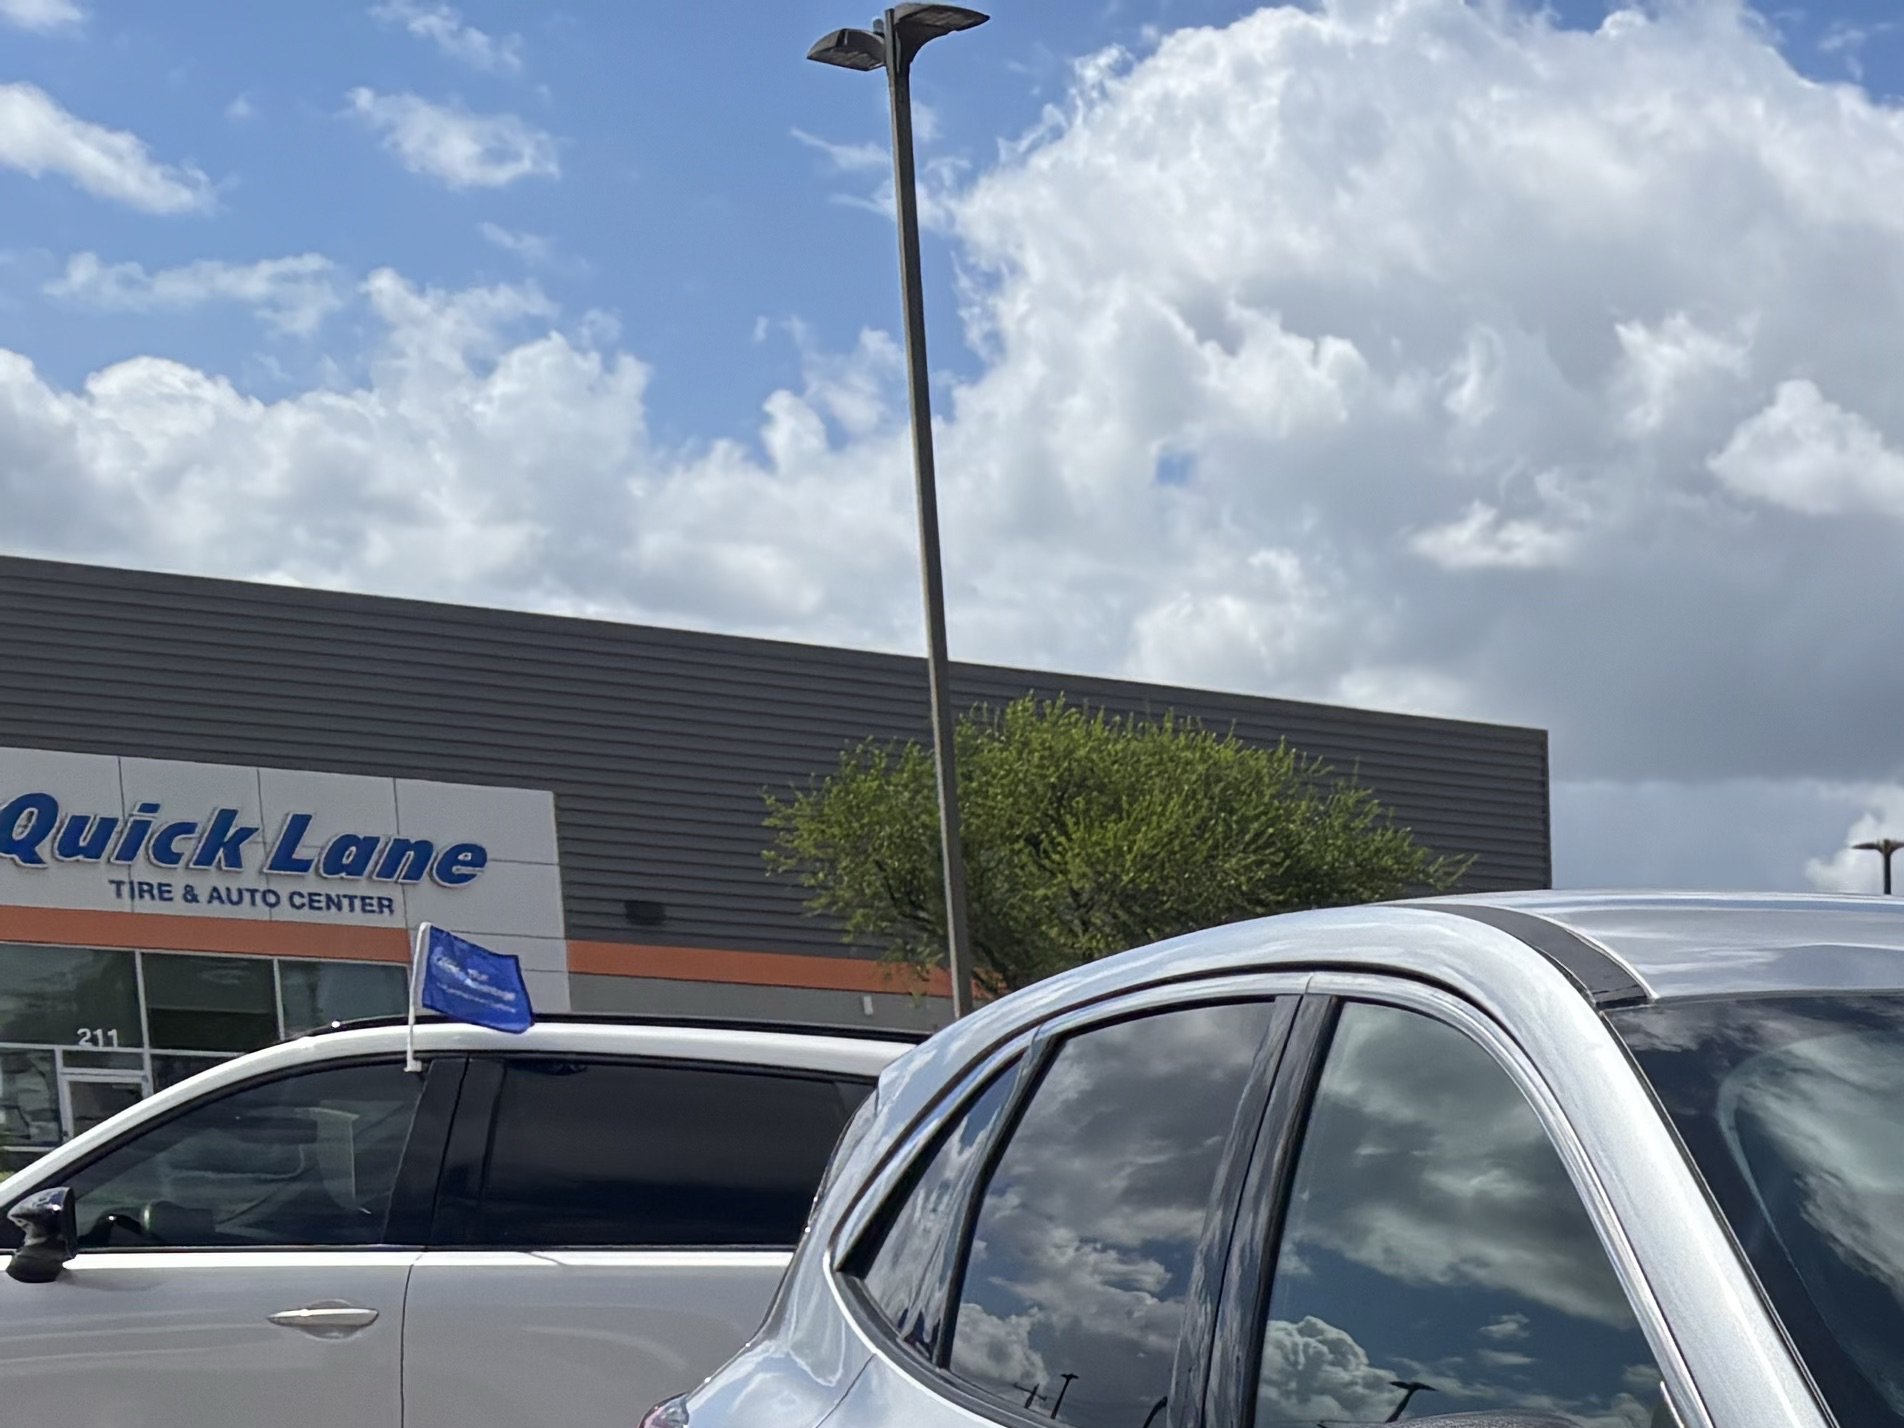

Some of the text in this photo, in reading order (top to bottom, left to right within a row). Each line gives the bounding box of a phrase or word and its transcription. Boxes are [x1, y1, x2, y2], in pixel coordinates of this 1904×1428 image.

[0, 792, 488, 888] Quick Lane
[108, 879, 395, 915] TIRE & AUTO CENTER
[77, 1028, 119, 1048] 211
